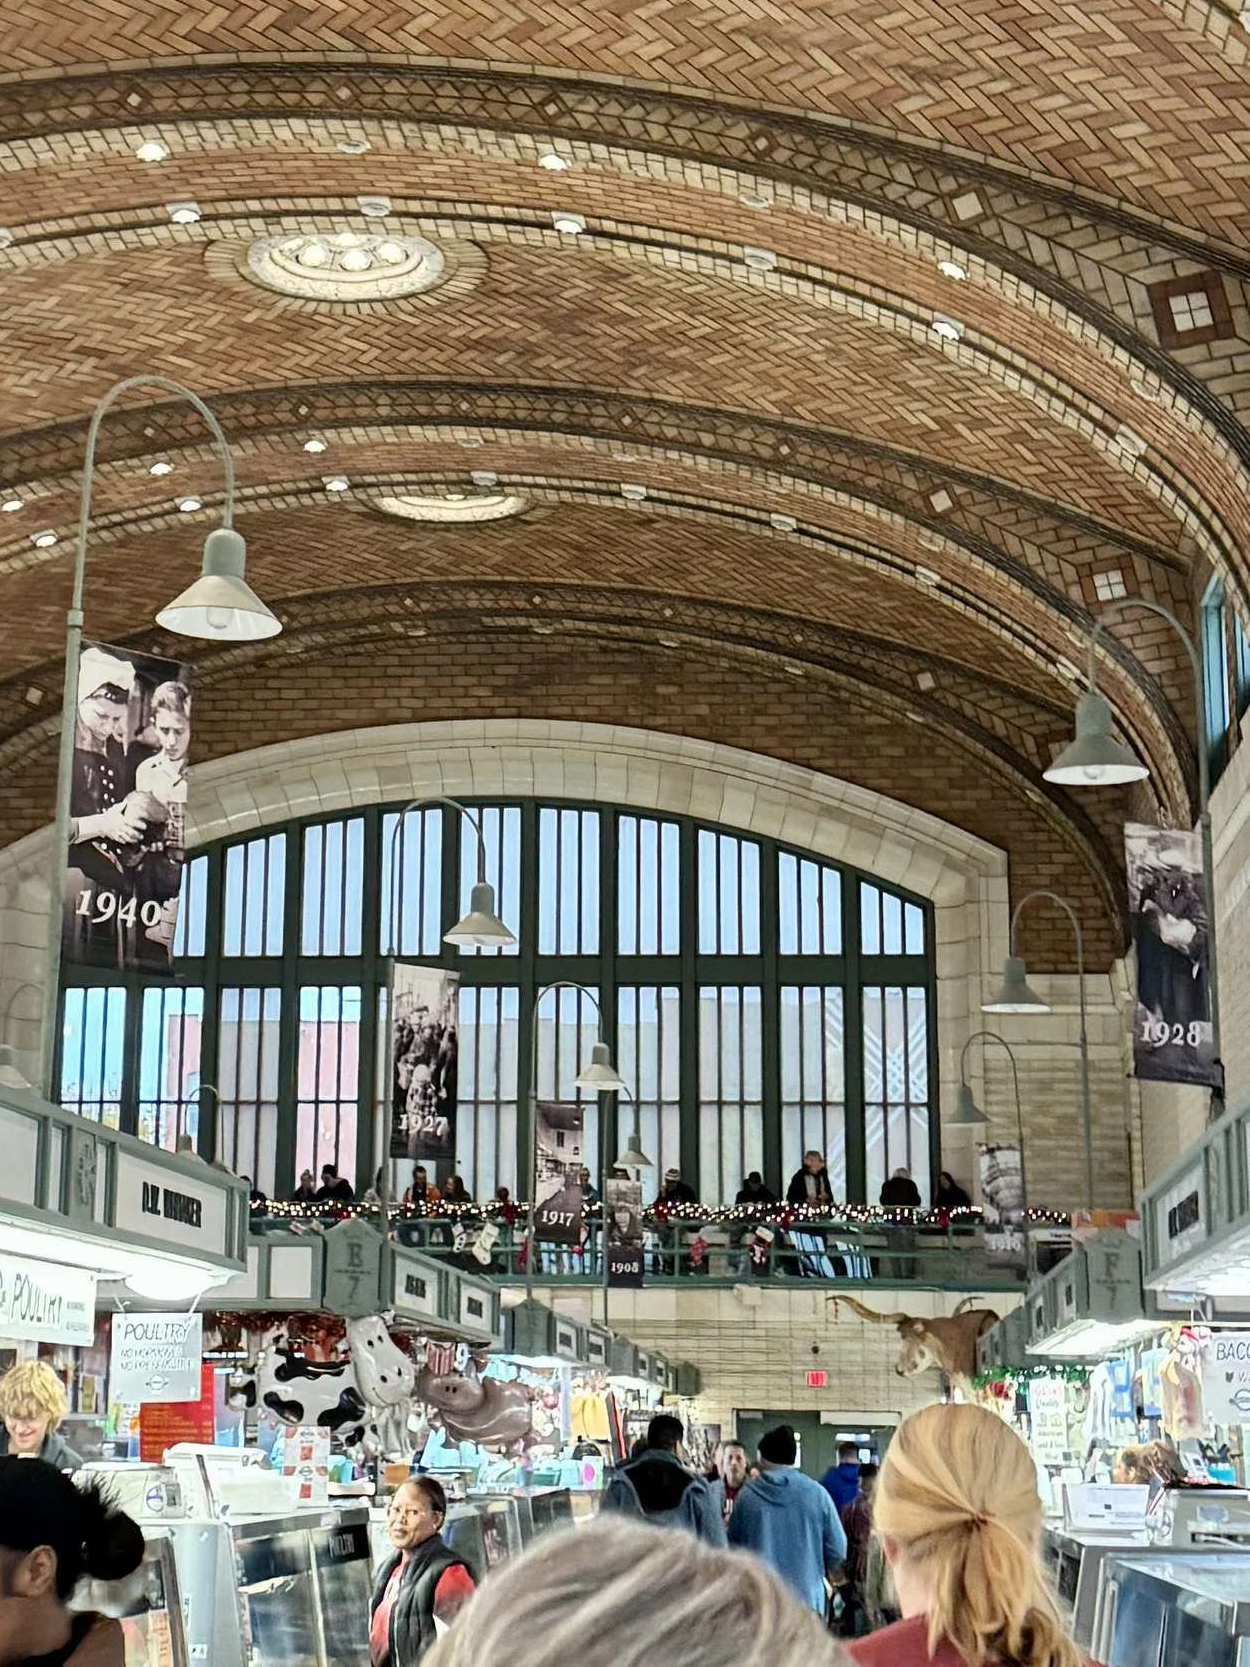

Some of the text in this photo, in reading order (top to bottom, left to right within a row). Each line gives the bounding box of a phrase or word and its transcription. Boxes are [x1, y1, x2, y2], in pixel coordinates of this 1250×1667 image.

[75, 889, 161, 928] 1940
[1140, 1020, 1201, 1047] 1928
[398, 1114, 449, 1136] 1927
[541, 1210, 575, 1228] 1917
[611, 1261, 639, 1274] 1908
[124, 1323, 191, 1341] POULTRY
